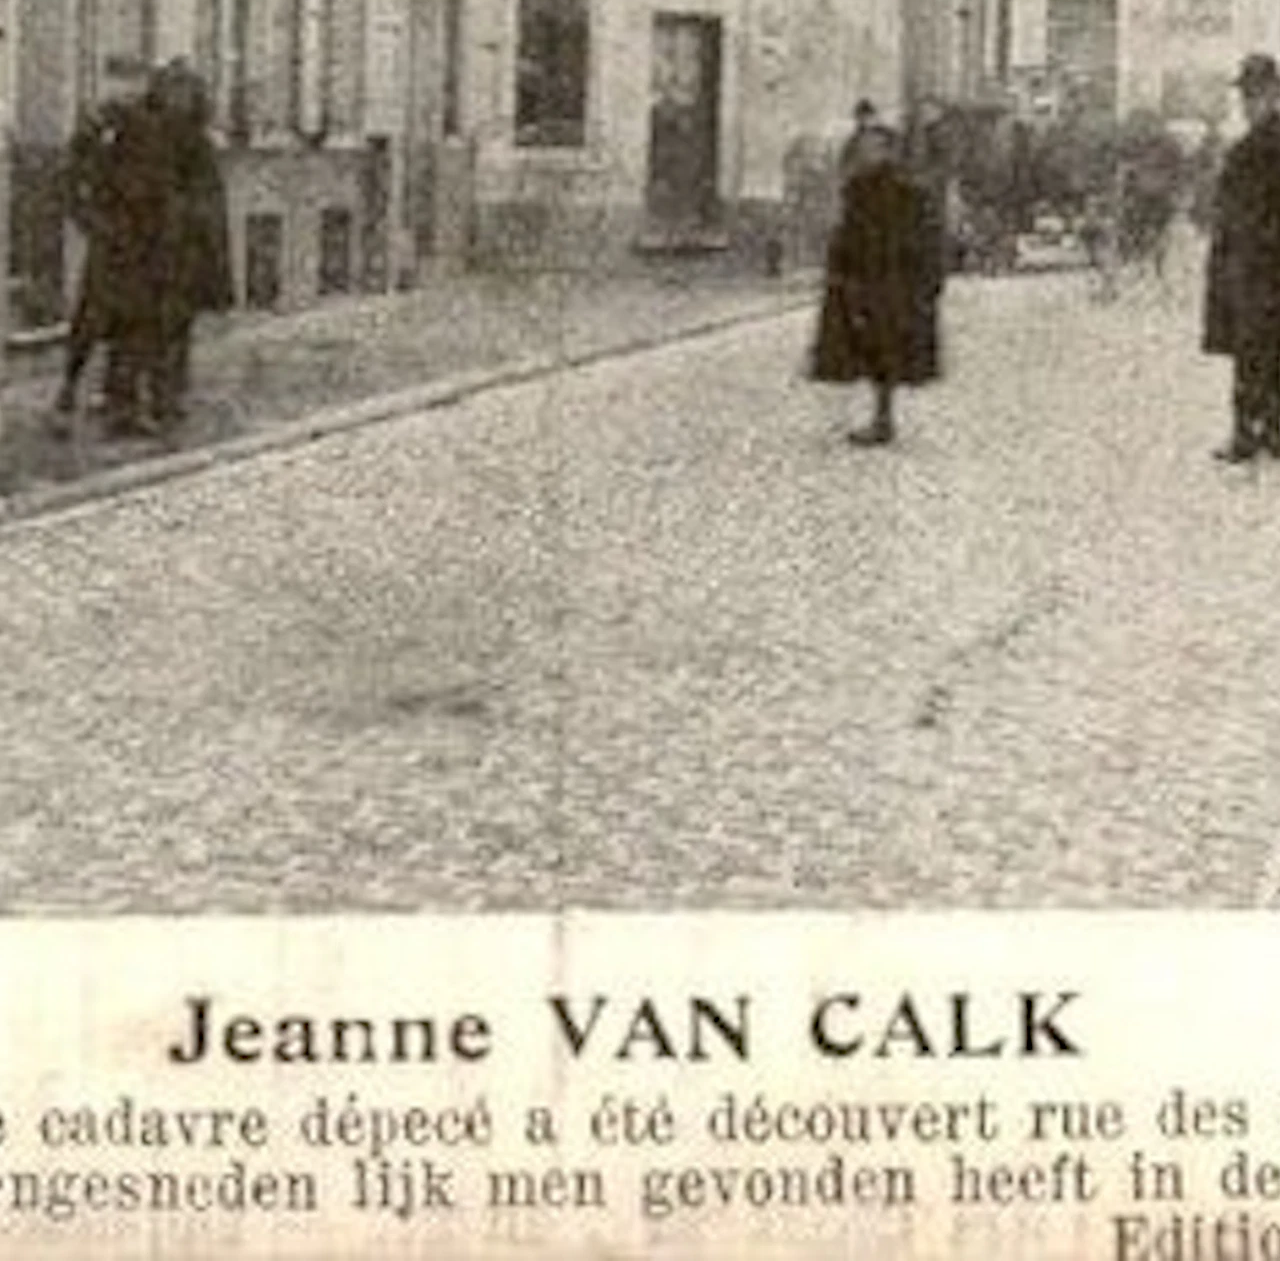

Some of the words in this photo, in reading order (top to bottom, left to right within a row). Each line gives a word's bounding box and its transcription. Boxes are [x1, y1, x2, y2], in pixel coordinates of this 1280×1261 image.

[167, 995, 493, 1065] Jeanne
[546, 994, 752, 1060] VAN
[810, 991, 1081, 1058] CALK
[39, 1094, 268, 1147] cadavre
[300, 1092, 494, 1155] dépecé
[524, 1106, 556, 1145] a
[590, 1095, 675, 1145] été
[706, 1091, 999, 1143] découvert
[1028, 1101, 1125, 1140] rue
[1157, 1088, 1250, 1137] des
[350, 1158, 457, 1220] lijk
[488, 1166, 606, 1208] men
[642, 1153, 916, 1217] gevonden
[950, 1153, 1098, 1203] heeft
[1129, 1151, 1185, 1202] in
